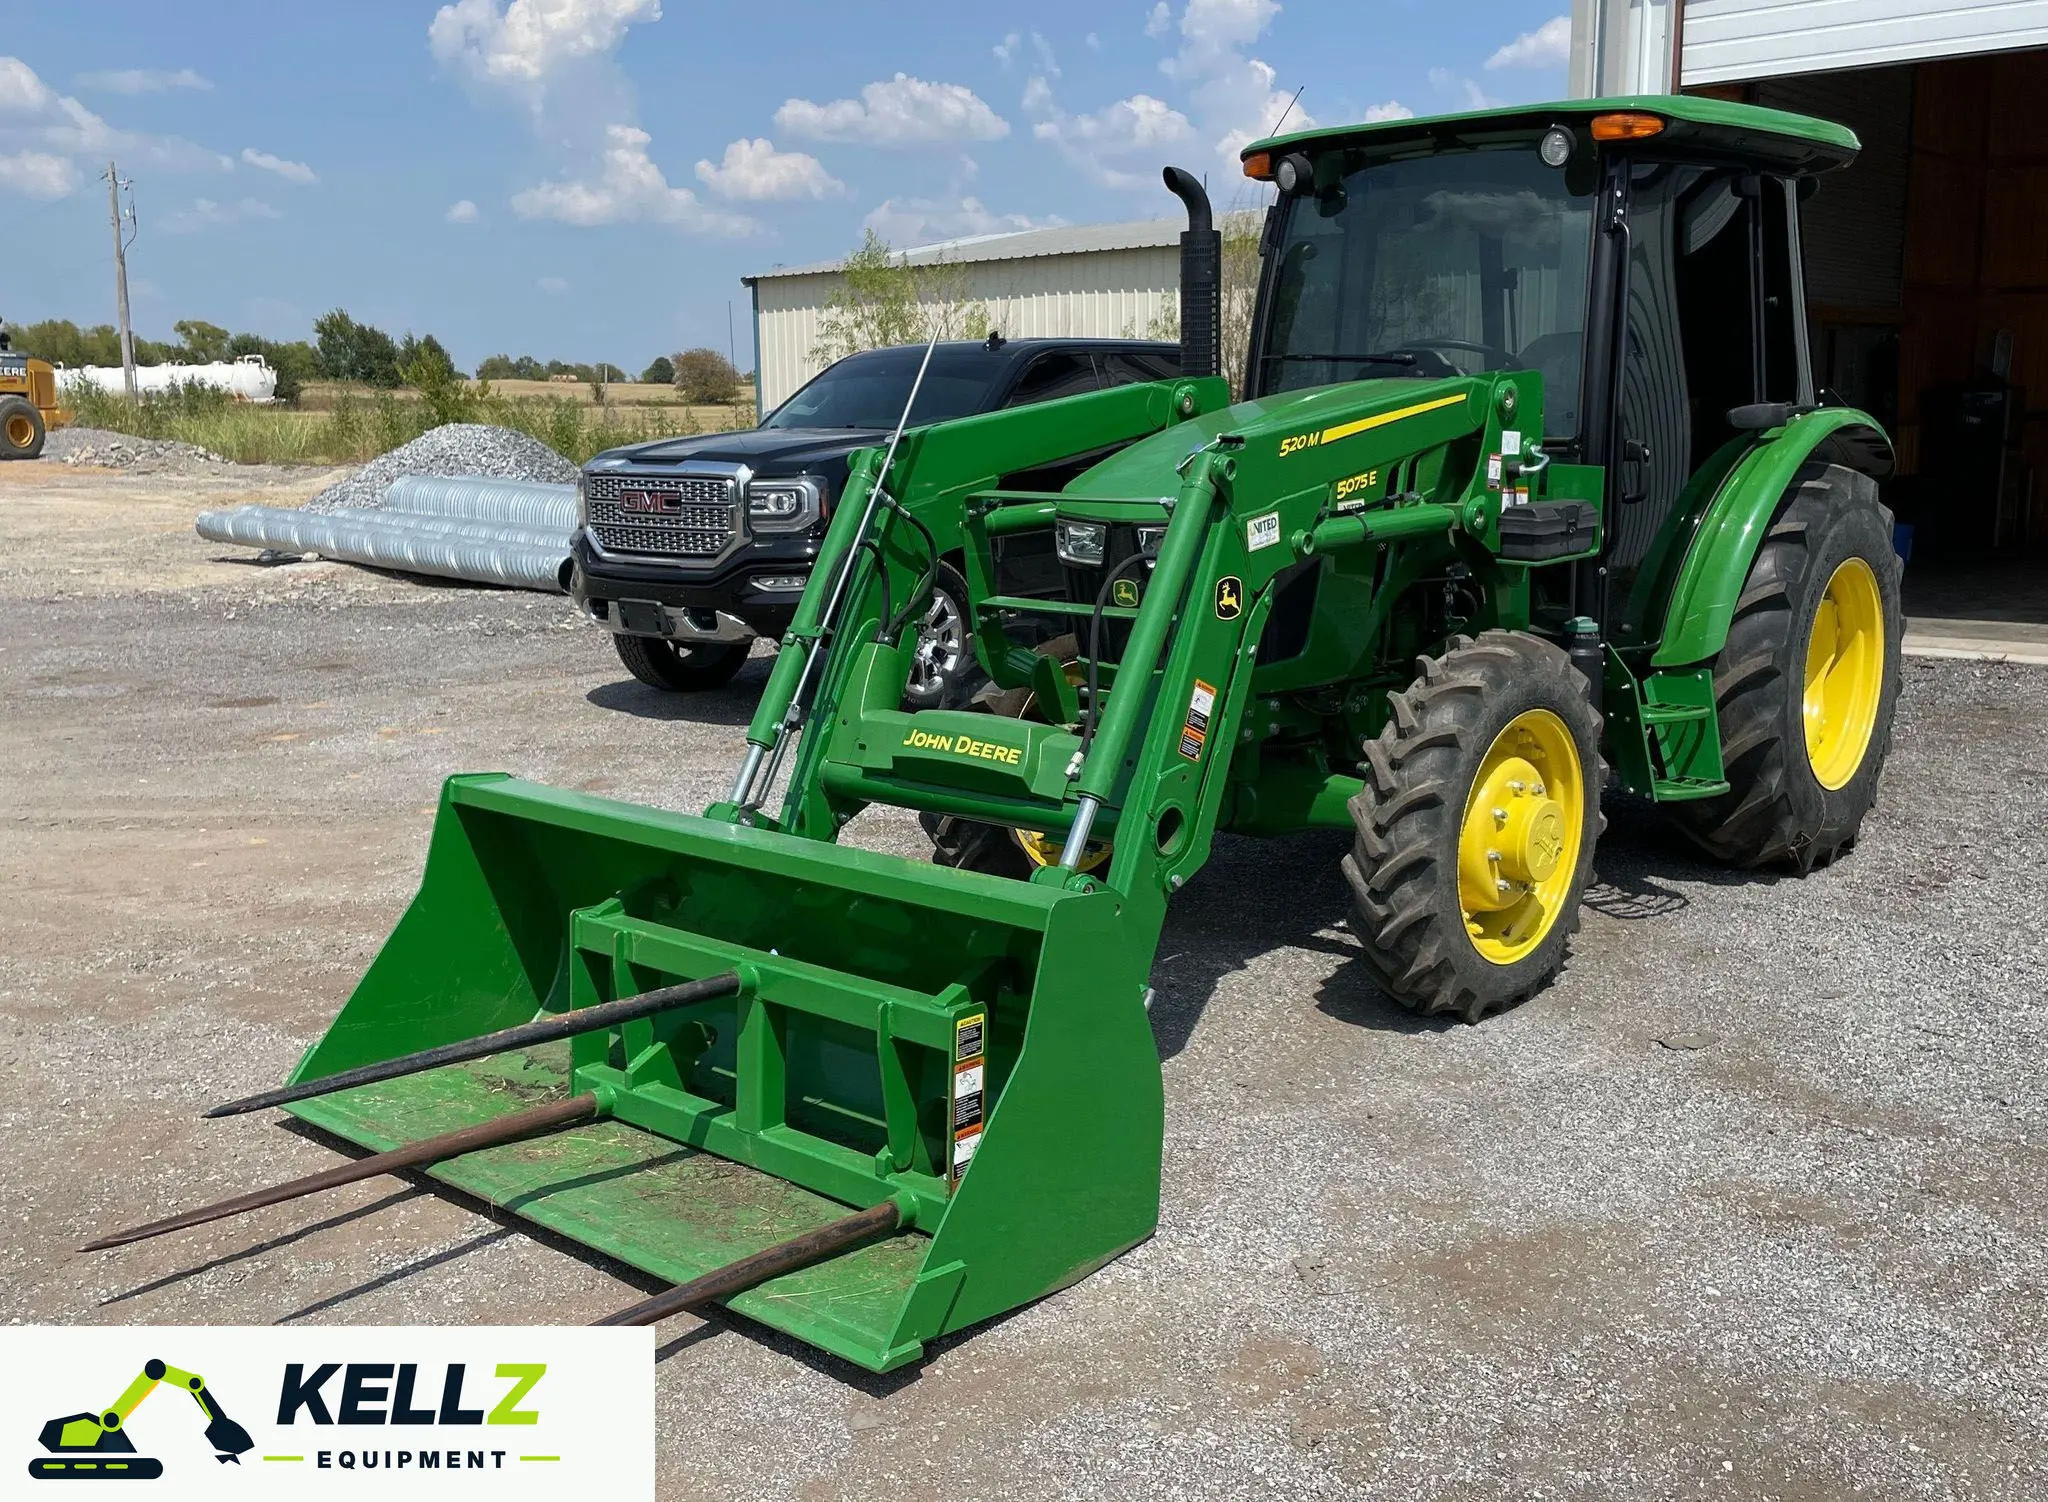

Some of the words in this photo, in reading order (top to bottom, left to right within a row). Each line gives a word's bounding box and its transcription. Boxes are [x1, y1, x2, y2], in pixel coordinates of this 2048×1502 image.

[621, 491, 681, 513] GMC
[903, 729, 953, 751] JOHN
[954, 735, 1022, 765] DEERE
